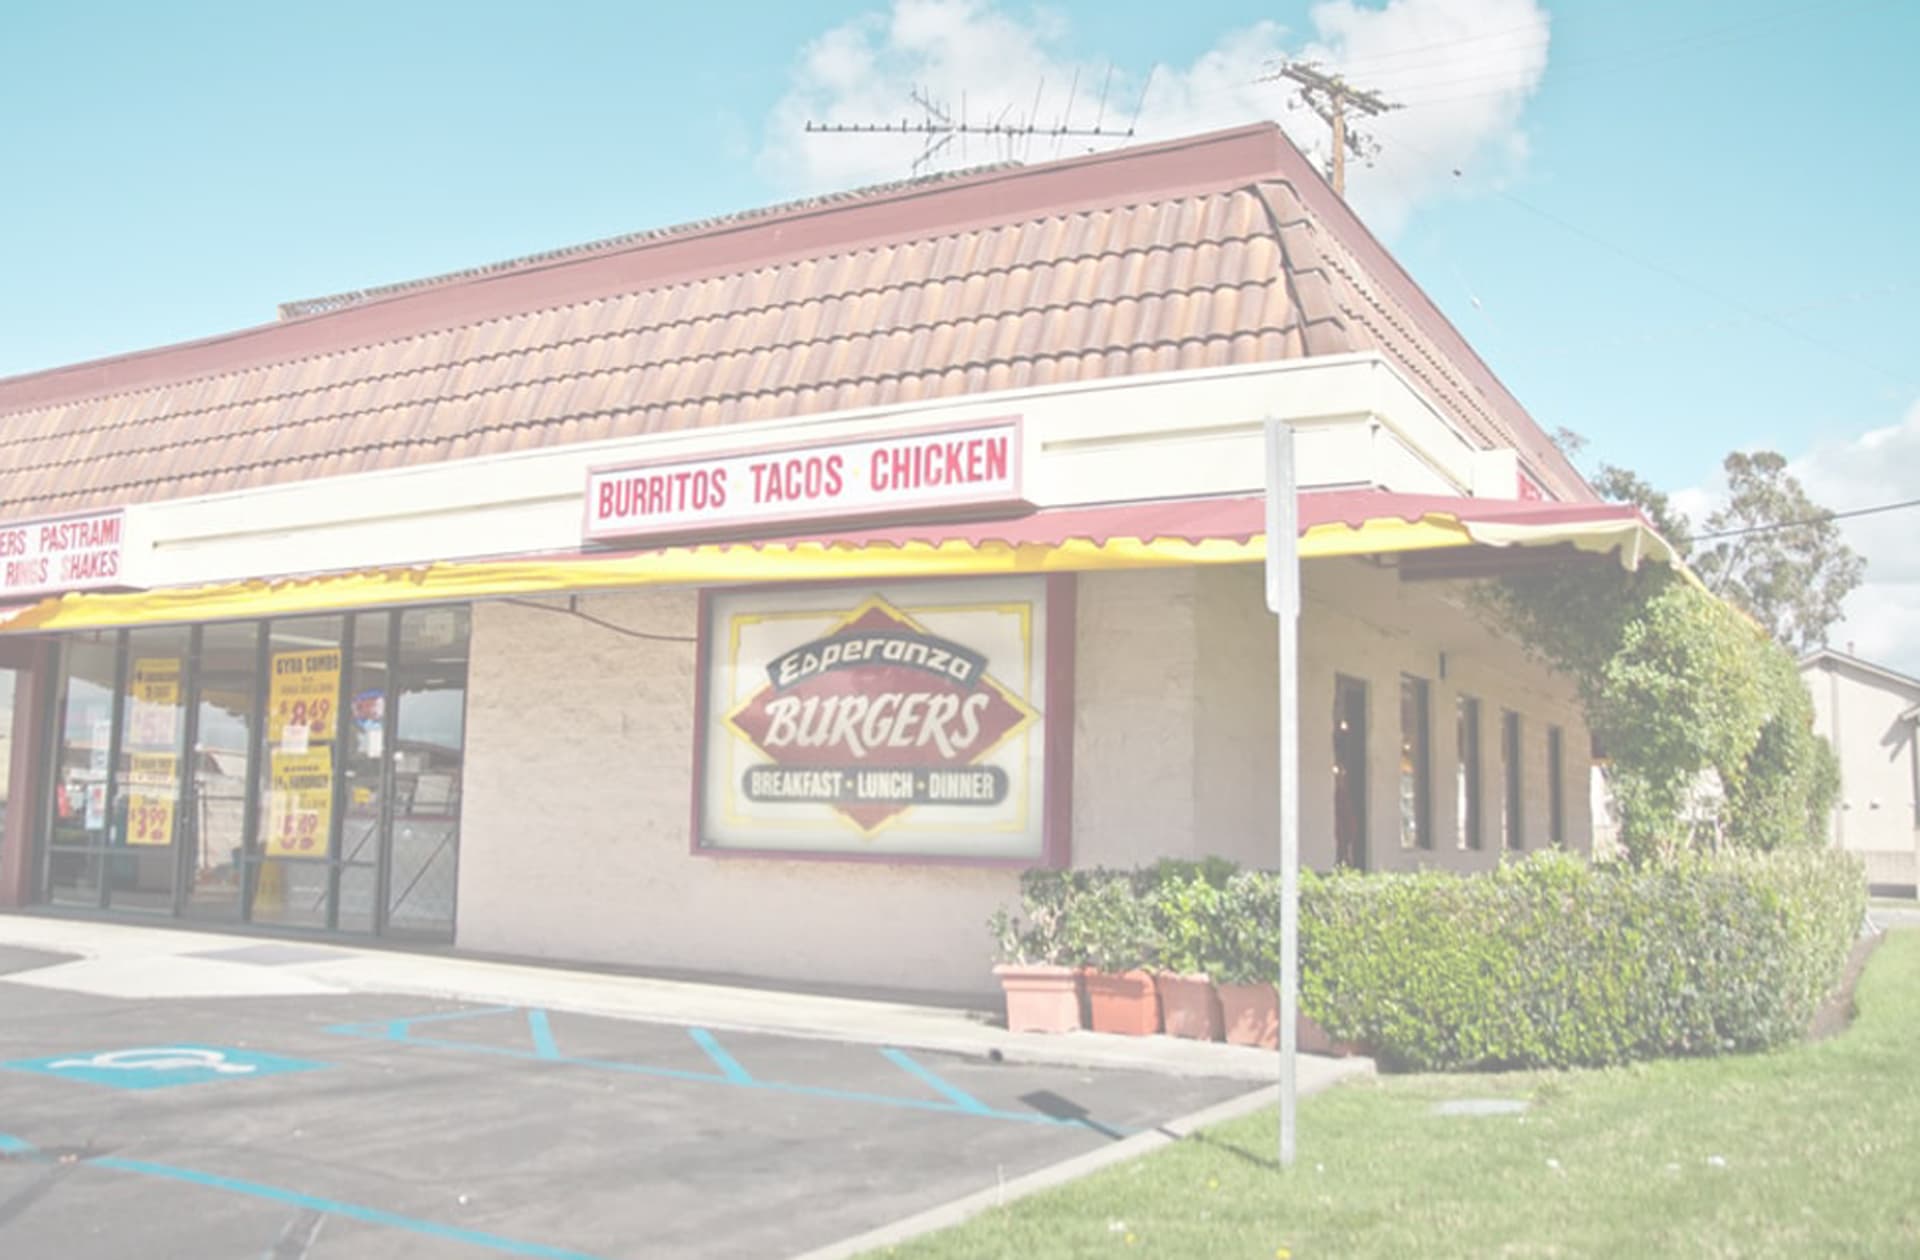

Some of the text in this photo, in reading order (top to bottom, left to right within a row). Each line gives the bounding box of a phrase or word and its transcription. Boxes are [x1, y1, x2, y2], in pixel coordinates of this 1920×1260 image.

[598, 437, 1008, 519] BURRITOS TACOS CHICKEN
[39, 518, 121, 552] PASTRAMI
[60, 550, 118, 582] SHAKES
[778, 638, 972, 685] Esperanza
[763, 692, 990, 758] BURGERS
[751, 768, 995, 799] BREAKFAST LUNCH DINNER
